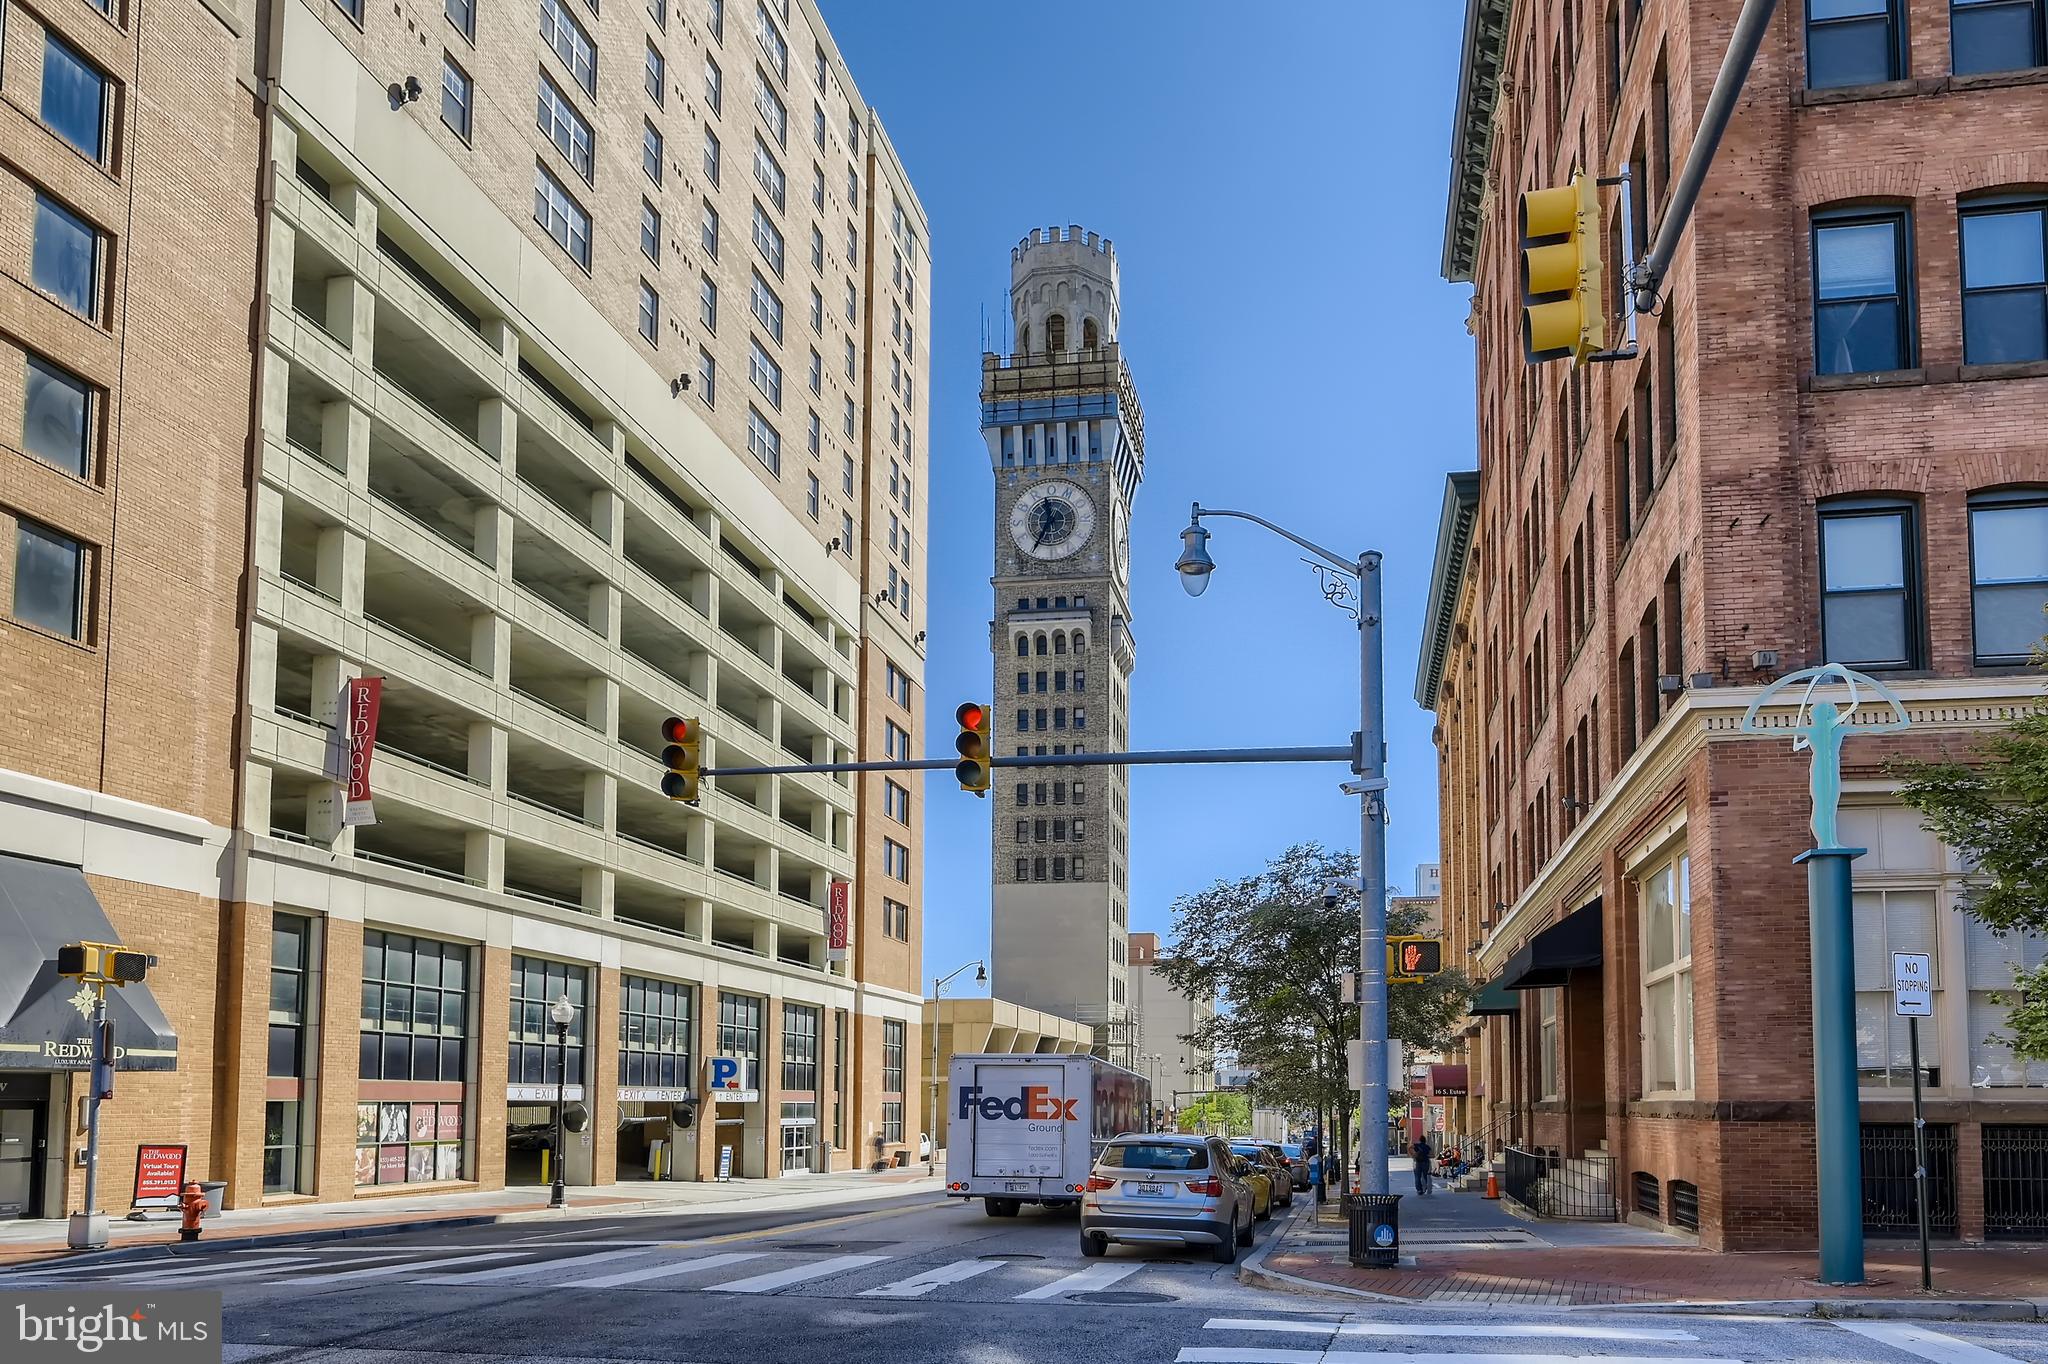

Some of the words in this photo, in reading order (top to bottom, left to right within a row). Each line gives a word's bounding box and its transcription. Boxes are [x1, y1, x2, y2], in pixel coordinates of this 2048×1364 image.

[351, 687, 371, 798] REDWOOD
[832, 887, 845, 948] REDWOOD
[1905, 962, 1918, 974] NO
[1897, 979, 1928, 992] STOPPING
[77, 1037, 93, 1045] THE
[44, 1040, 125, 1060] REDWD
[711, 1059, 738, 1089] P
[535, 1088, 554, 1099] EXIT
[624, 1090, 640, 1099] EXIT
[661, 1090, 682, 1100] ENTER
[725, 1092, 744, 1101] ENTER
[959, 1086, 1079, 1121] FedEx
[422, 1108, 435, 1116] THE
[1028, 1123, 1063, 1133] Ground
